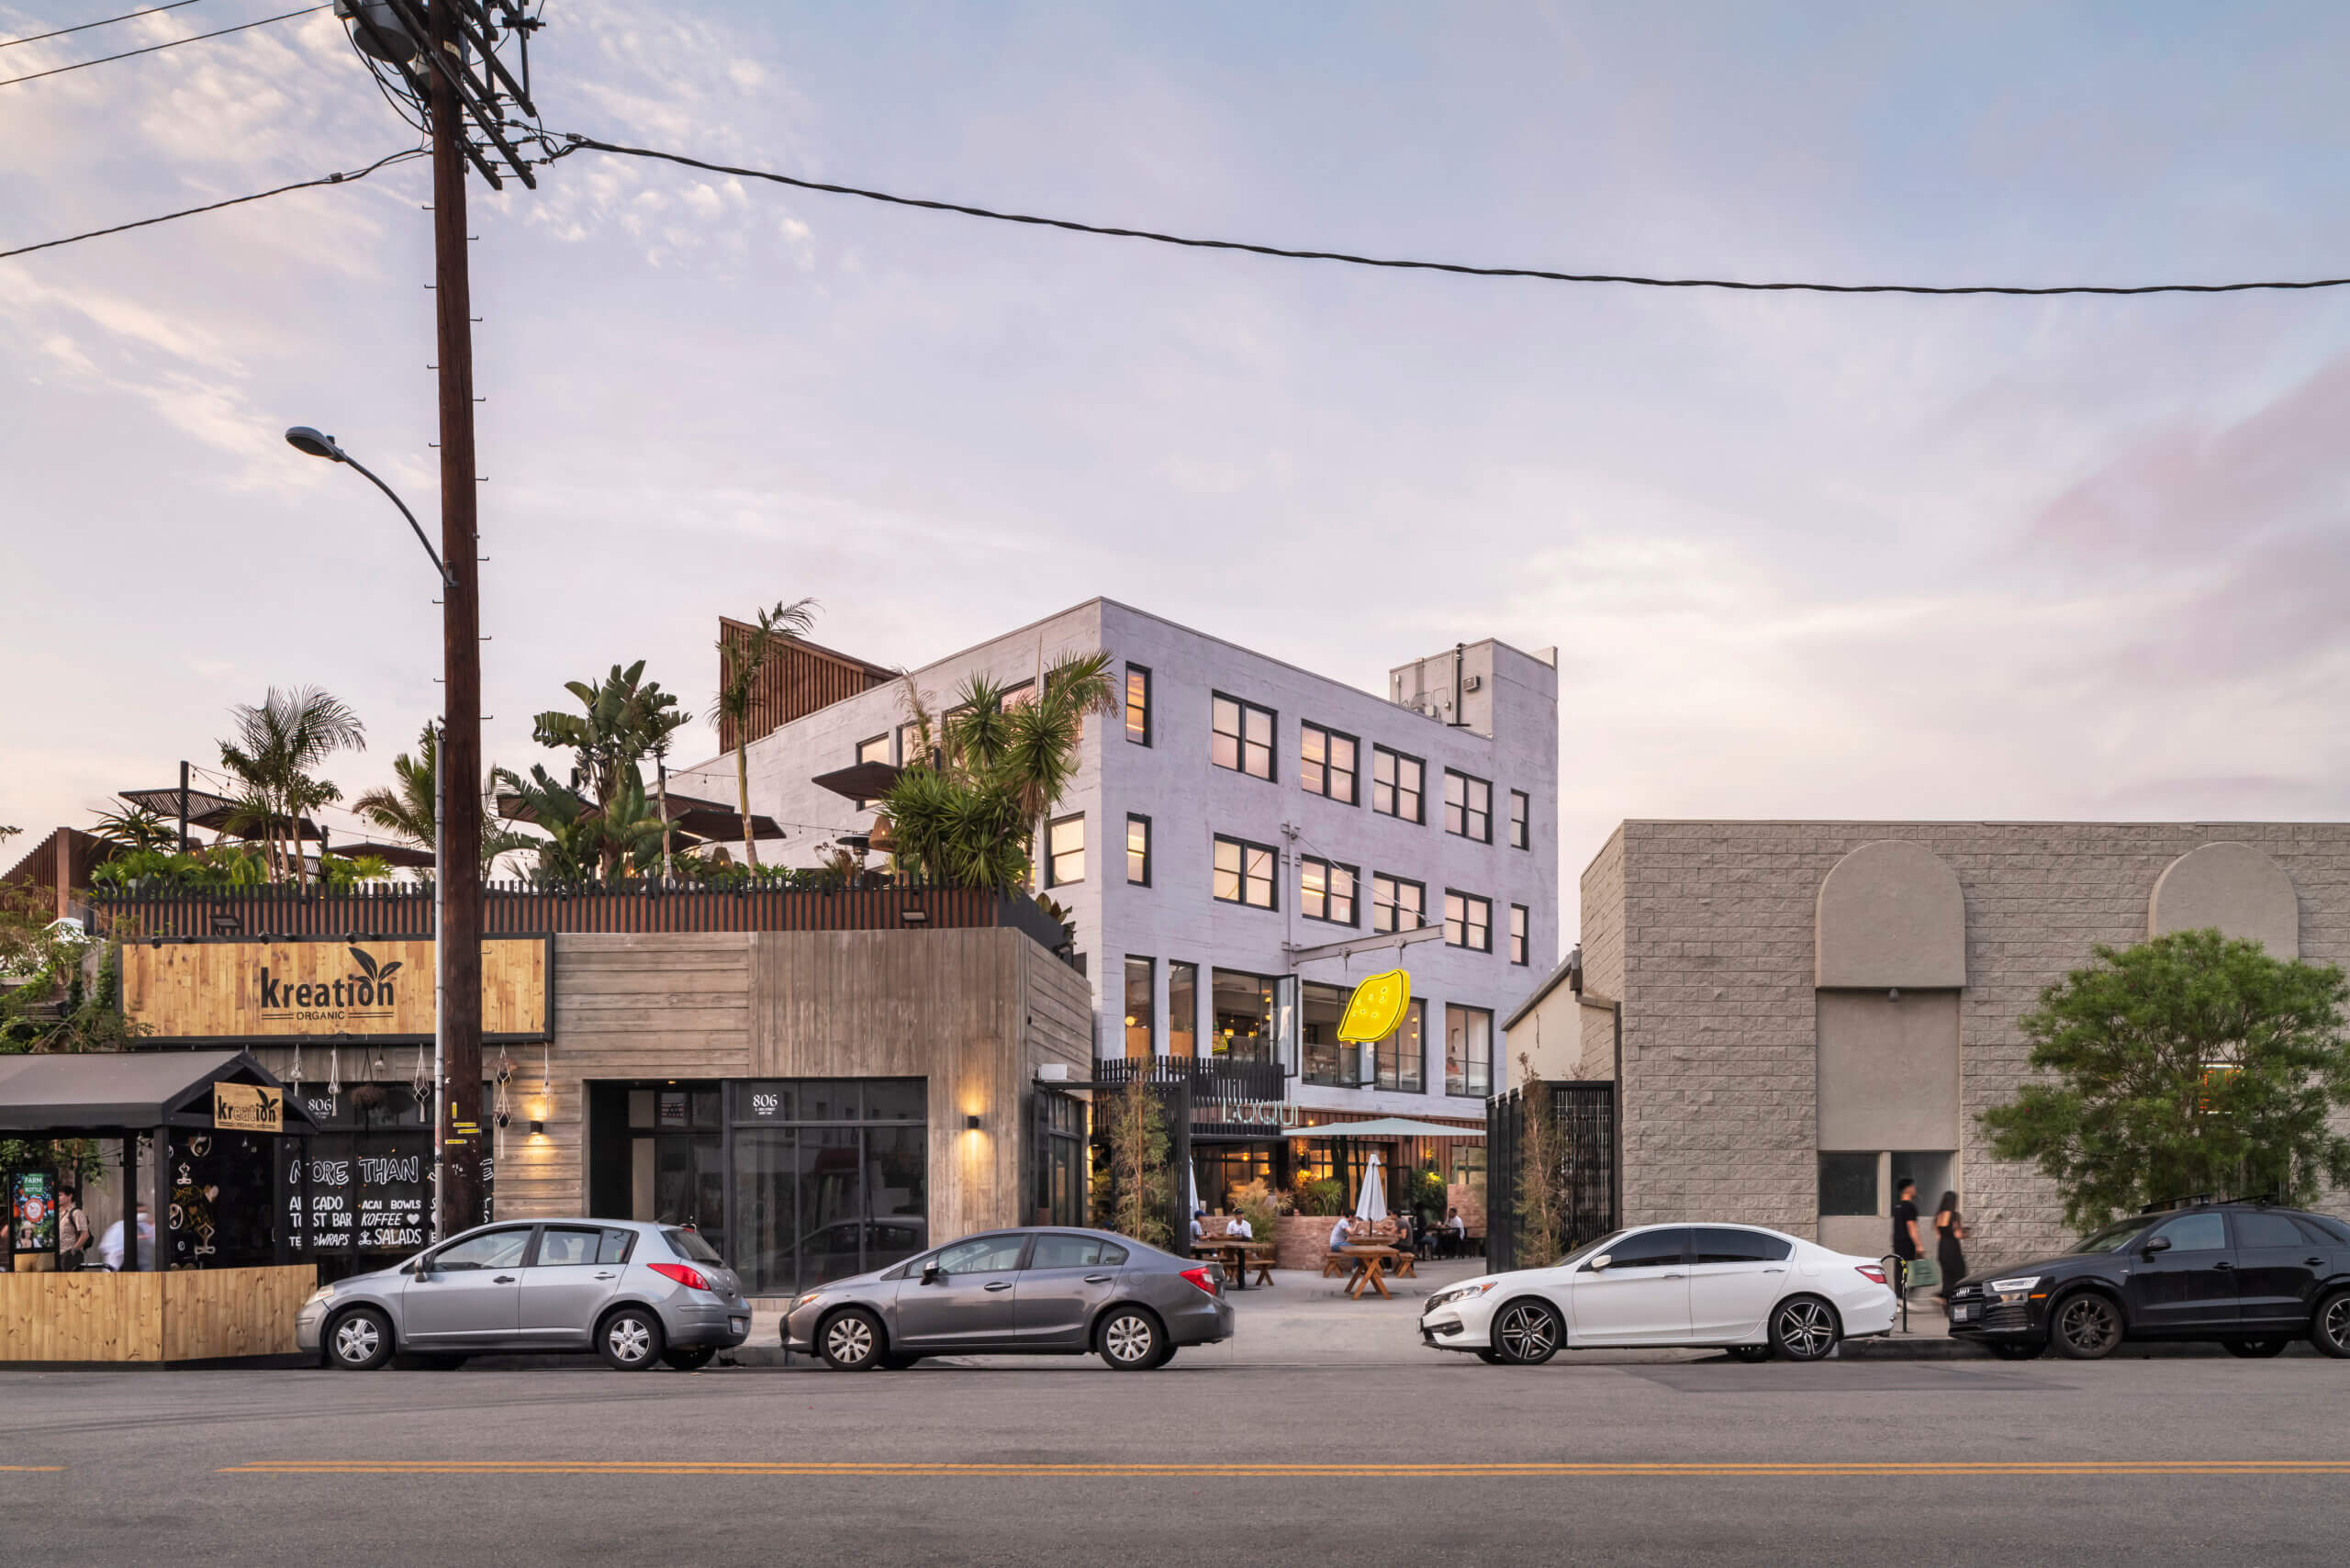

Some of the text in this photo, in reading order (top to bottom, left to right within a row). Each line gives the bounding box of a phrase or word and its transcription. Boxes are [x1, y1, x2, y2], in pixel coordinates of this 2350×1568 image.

[261, 967, 395, 1008] kreation
[297, 1012, 345, 1020] ORGANIC
[308, 1099, 331, 1111] 806
[753, 1094, 778, 1107] 806
[218, 1095, 275, 1123] kreation
[359, 1156, 419, 1185] THAN
[362, 1200, 383, 1209] ACAI
[390, 1199, 421, 1209] BOWLS
[332, 1213, 352, 1227] BAR
[361, 1213, 401, 1226] KOFFEE
[319, 1233, 350, 1247] WRAPS
[374, 1227, 422, 1245] SALADS
